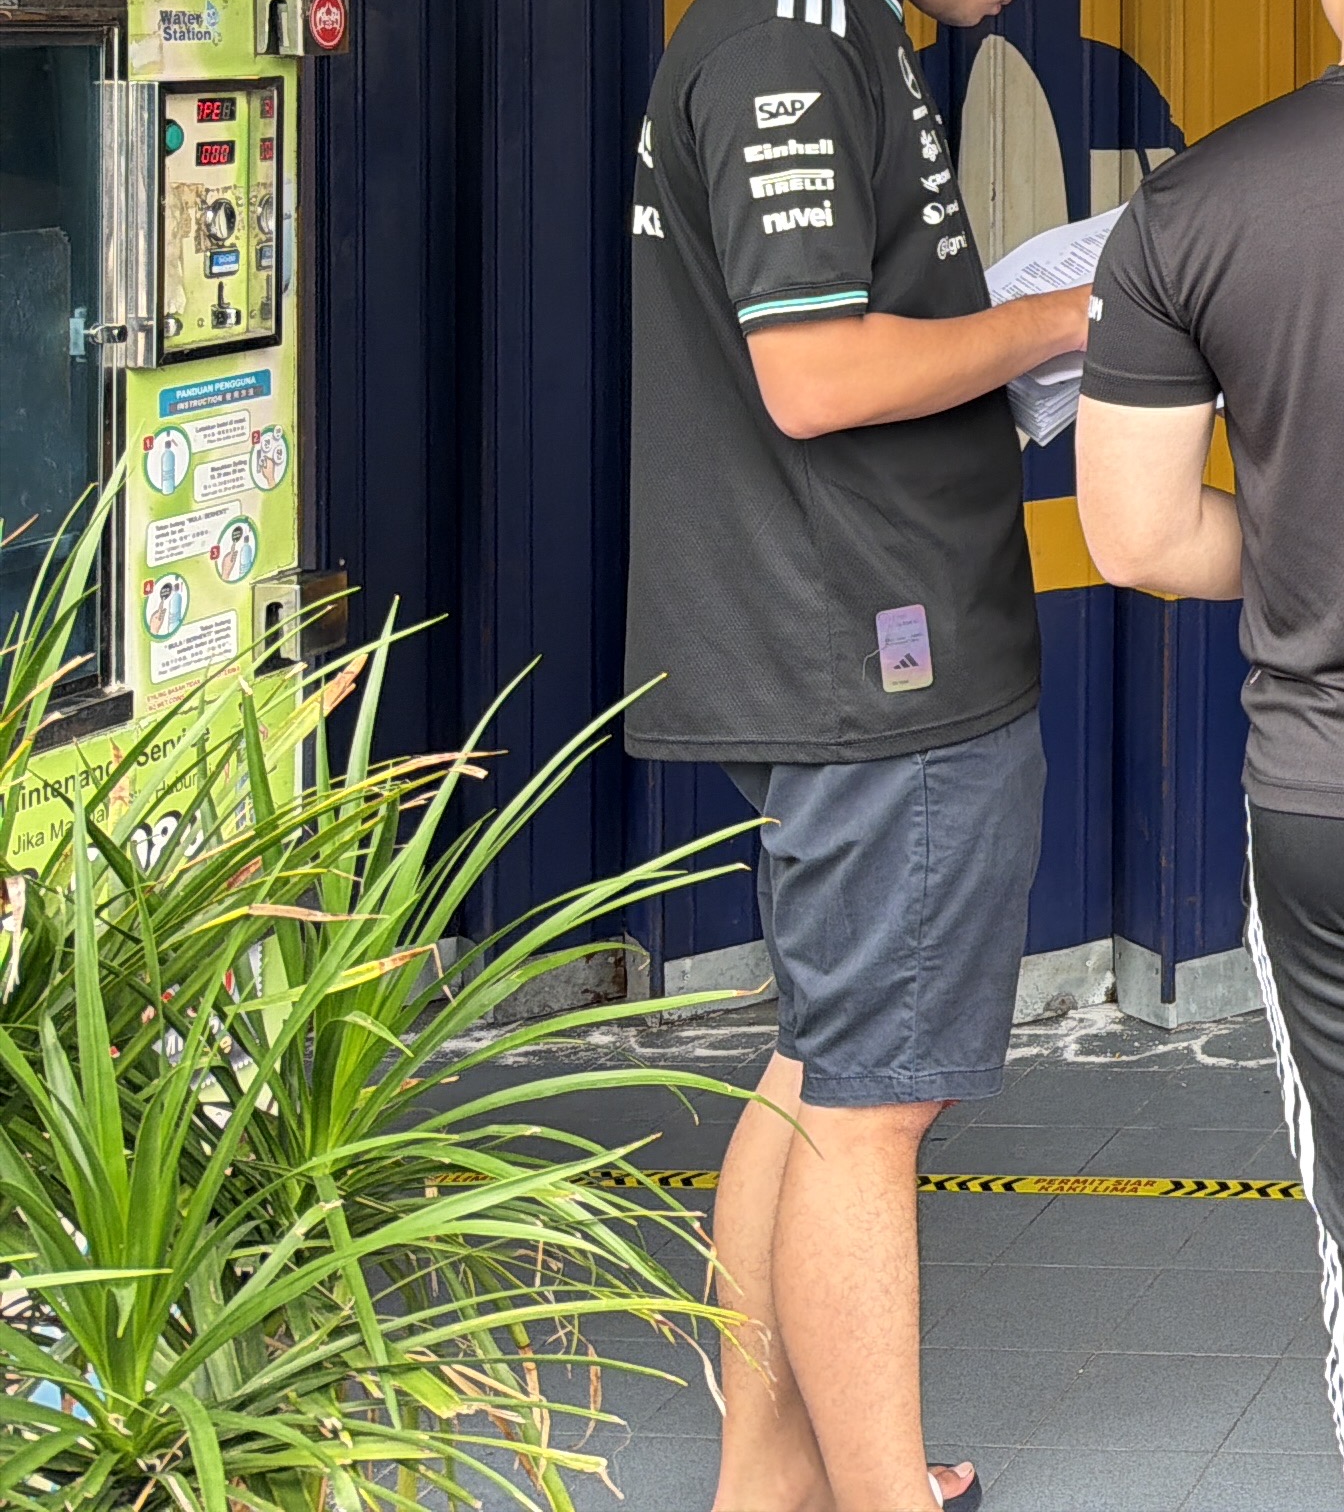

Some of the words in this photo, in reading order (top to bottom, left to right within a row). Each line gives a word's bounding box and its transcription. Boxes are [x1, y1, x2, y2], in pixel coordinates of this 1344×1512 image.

[160, 10, 203, 26] Water
[163, 26, 212, 42] Station
[758, 99, 805, 122] SAP
[744, 138, 834, 163] Einhell
[750, 169, 834, 199] PIRELLI
[763, 201, 834, 235] nuvei
[176, 383, 213, 400] PANDUAN
[215, 375, 257, 391] PENGGUNA
[12, 830, 45, 856] Jika
[1033, 1178, 1110, 1186] PERMIT
[1112, 1179, 1158, 1188] SIAR
[1038, 1185, 1087, 1193] KAKI
[1091, 1186, 1139, 1194] LIMA
